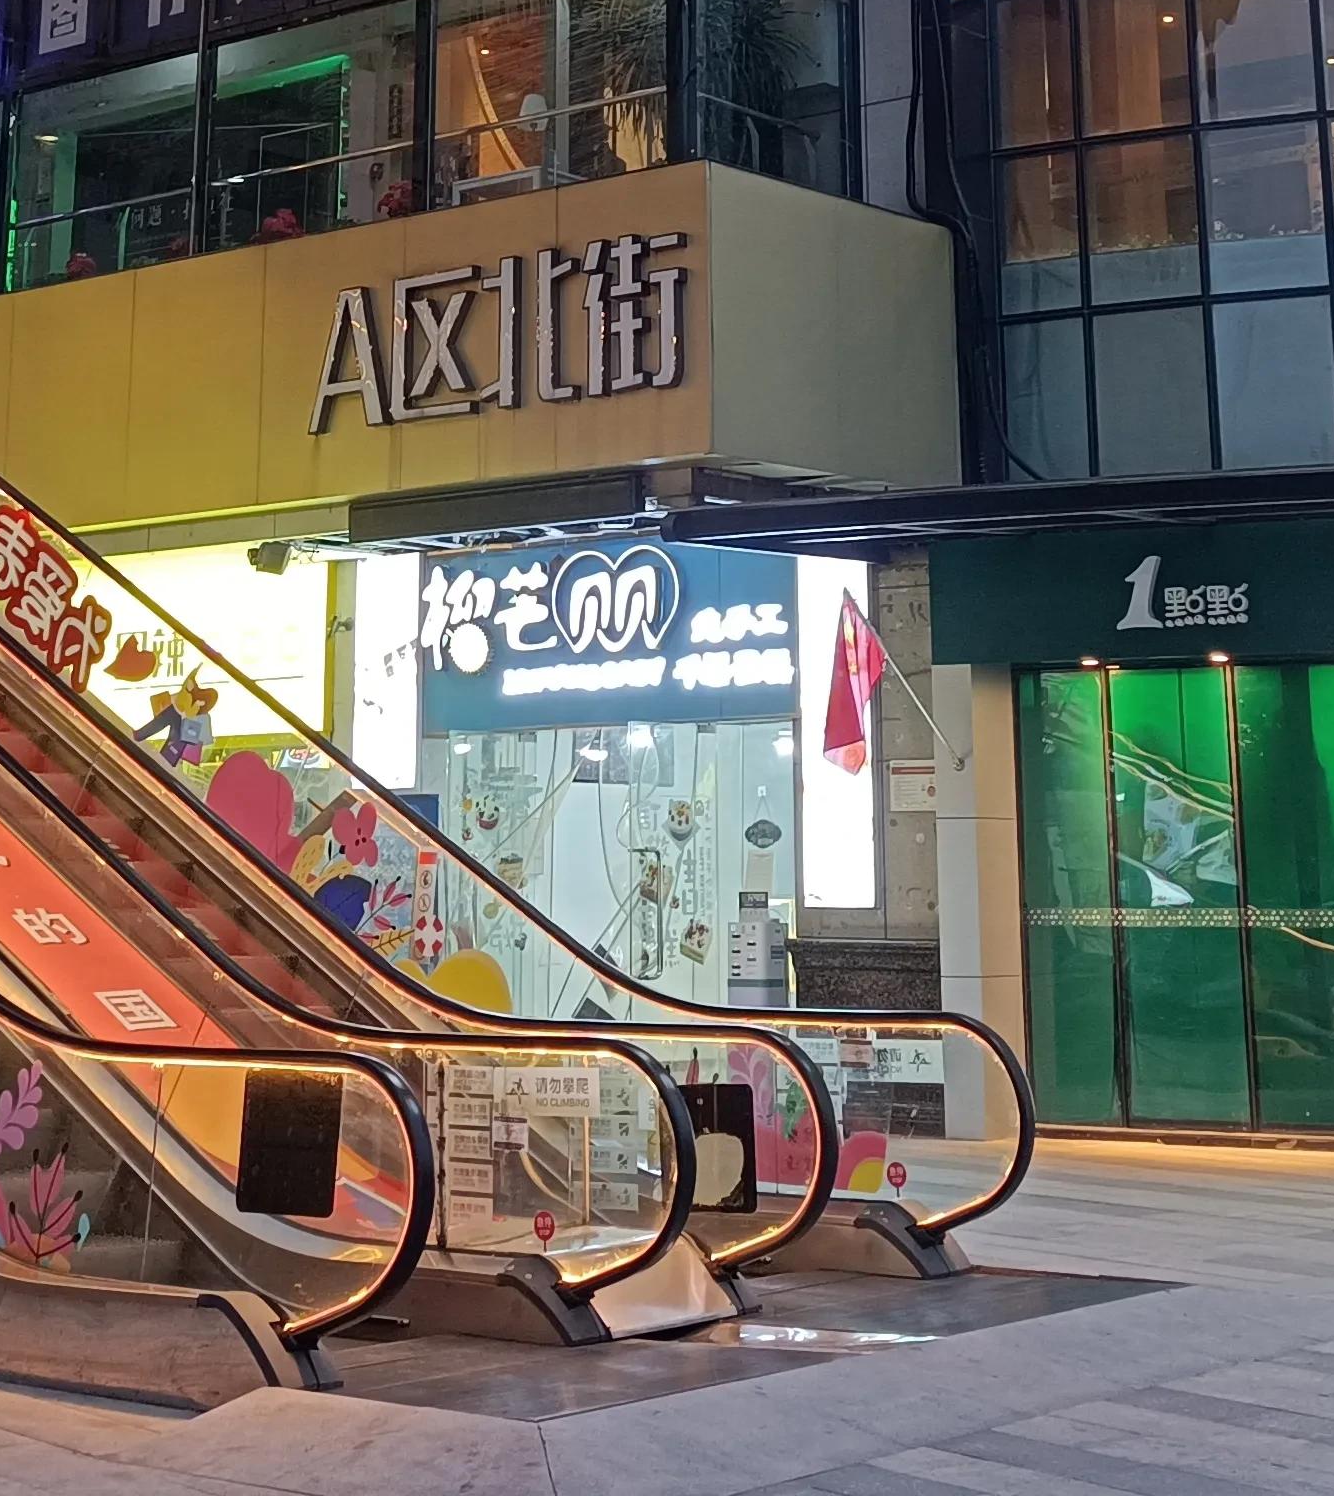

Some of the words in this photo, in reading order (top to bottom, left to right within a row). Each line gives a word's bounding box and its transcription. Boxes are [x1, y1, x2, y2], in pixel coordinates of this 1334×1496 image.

[308, 231, 688, 436] A区北街
[534, 1076, 590, 1095] 请勿攀爬
[536, 1097, 551, 1108] NO
[553, 1097, 591, 1109] CLIMBING
